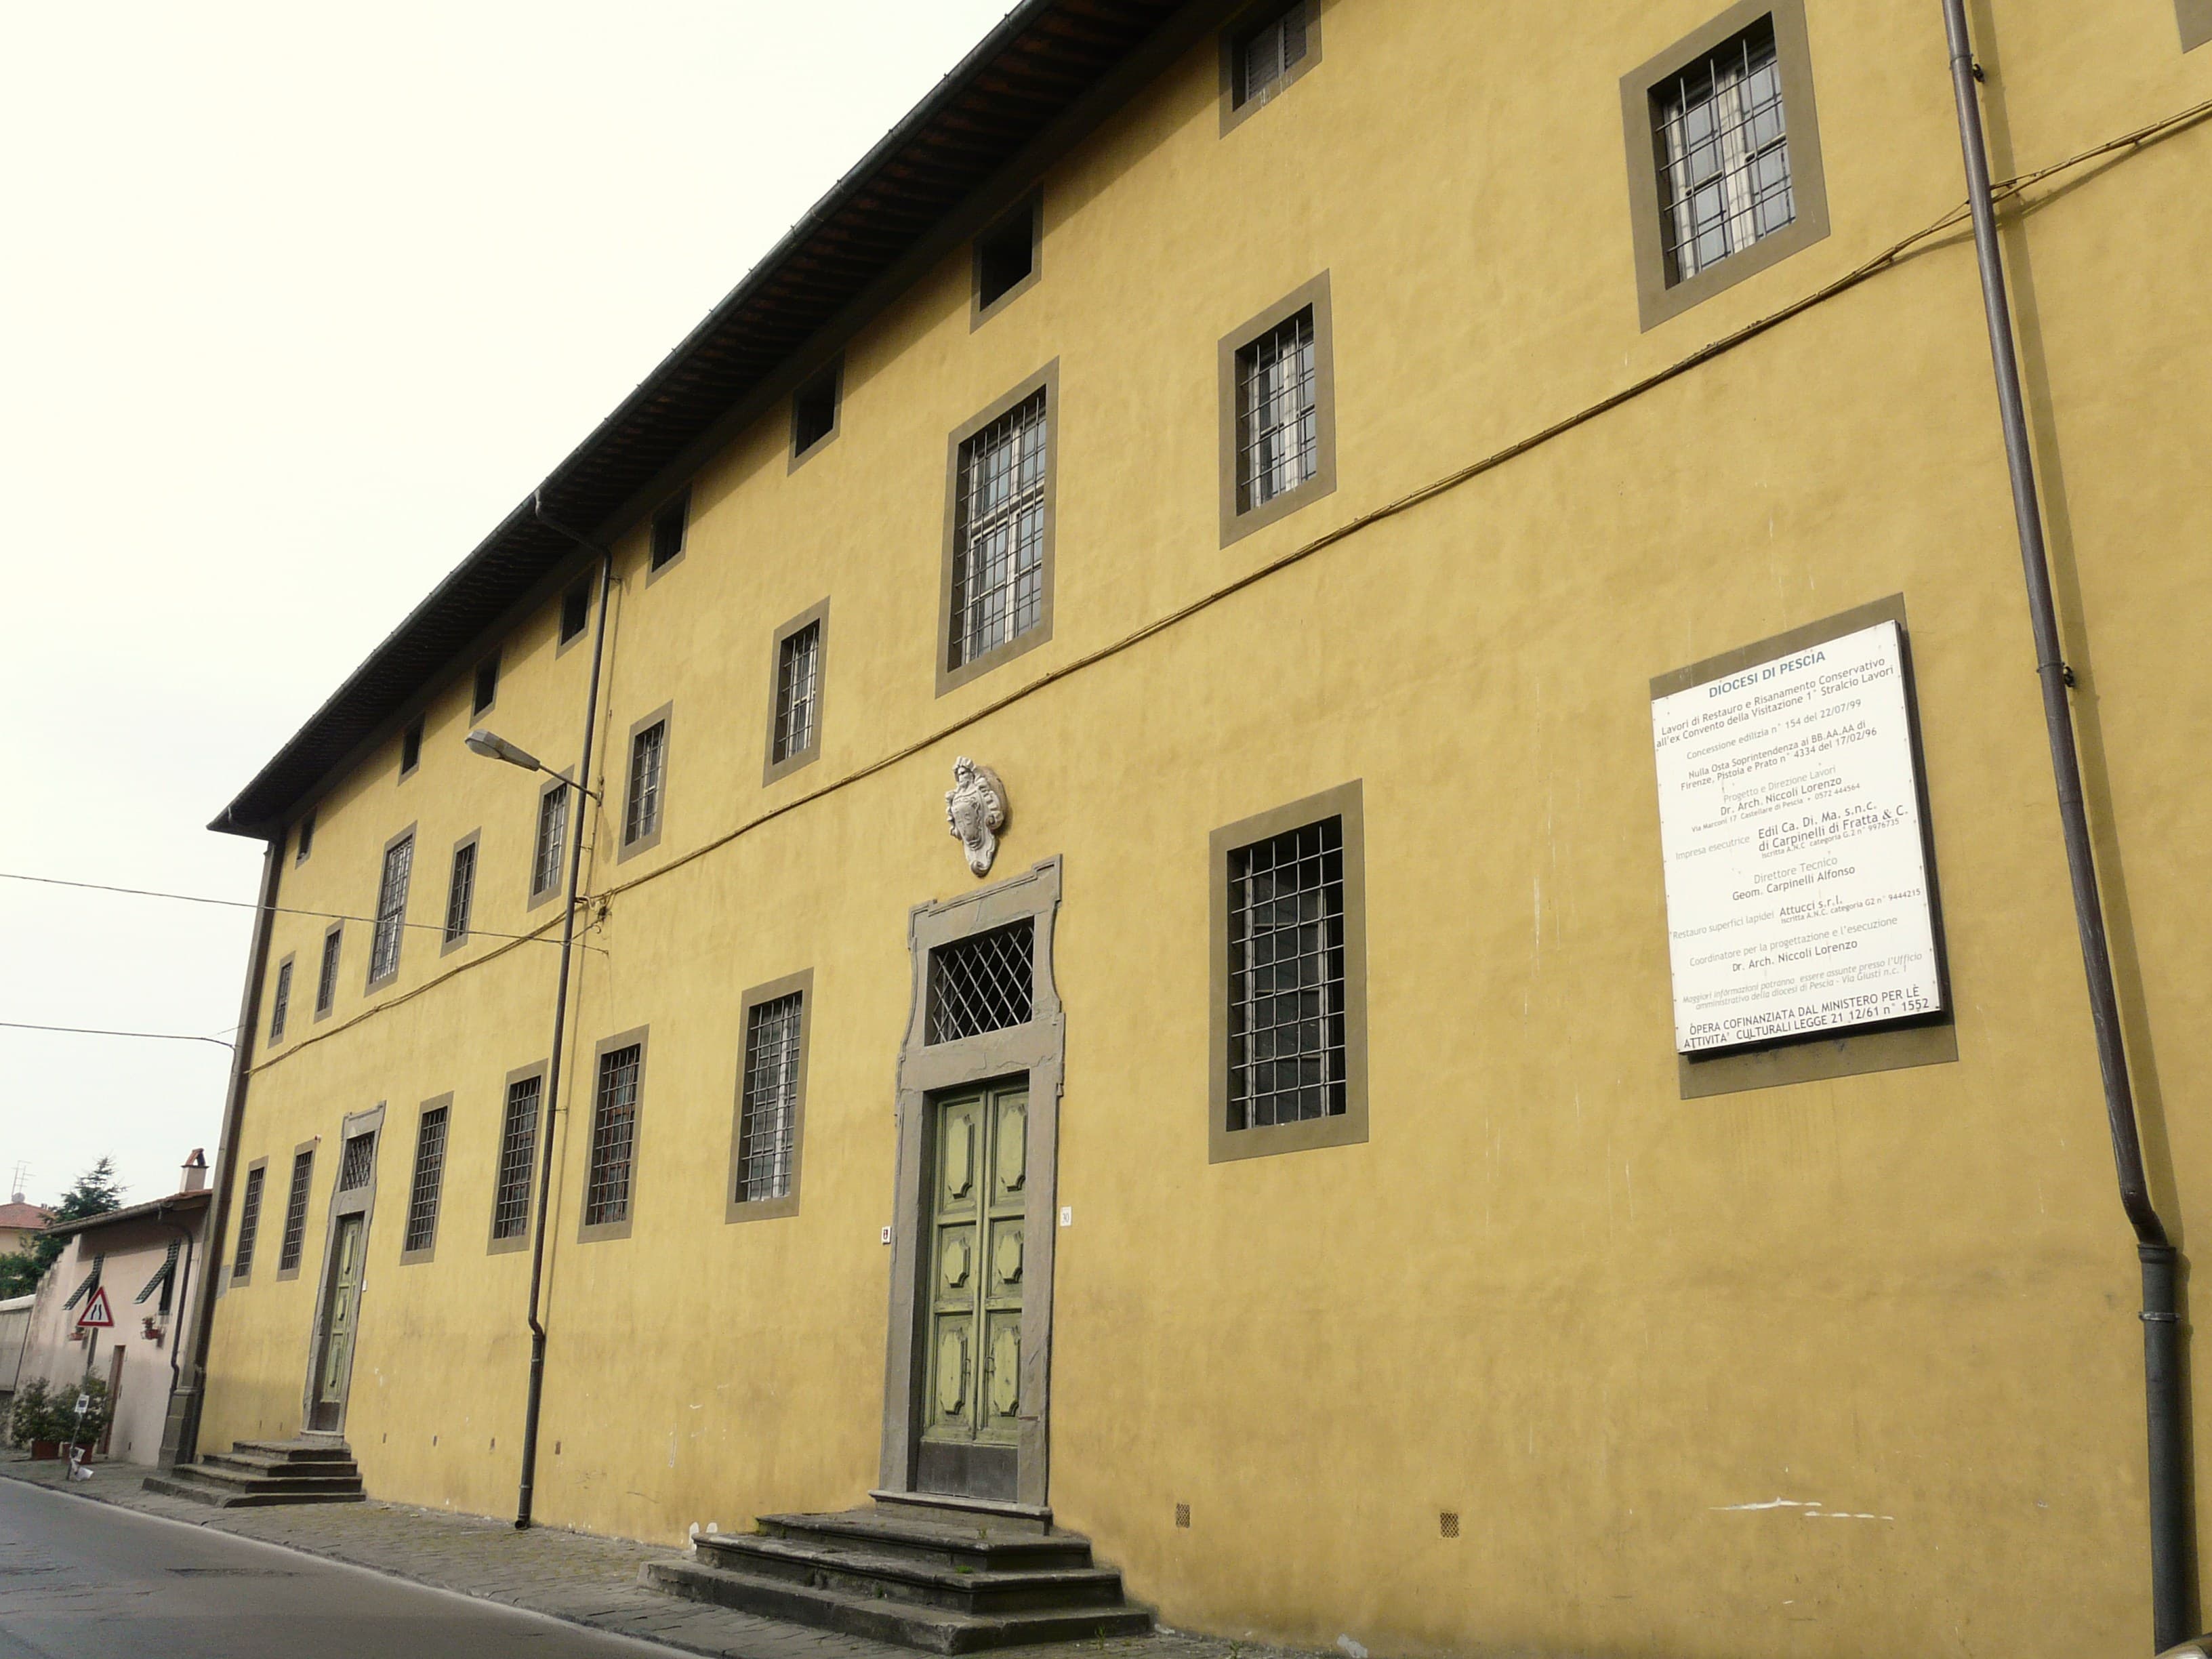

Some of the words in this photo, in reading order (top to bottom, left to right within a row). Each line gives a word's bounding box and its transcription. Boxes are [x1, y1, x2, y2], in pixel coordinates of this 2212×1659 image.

[1709, 673, 1758, 697] DIOCESI
[1763, 667, 1776, 680] DI
[1780, 651, 1825, 674] PESCIA
[1656, 735, 1680, 747] all'ex
[1683, 721, 1724, 739] Convento
[1728, 713, 1749, 725] della
[1752, 695, 1803, 717] Visitazione
[1822, 678, 1858, 695] Stralcio
[1862, 665, 1893, 683] Lavori
[1662, 720, 1689, 735] Lavori
[1692, 716, 1700, 726] di
[1702, 704, 1742, 722] Restauro
[1755, 680, 1816, 705] Risanamento
[1819, 659, 1885, 684] Conservativo
[1687, 740, 1736, 759] Concessione
[1739, 730, 1769, 743] edilizia
[1786, 718, 1801, 729] 154
[1804, 713, 1818, 723] del
[1821, 699, 1861, 718] 22/07/99
[1689, 768, 1709, 779] Nulla
[1712, 762, 1729, 772] Osta
[1732, 742, 1799, 766] Soprintendenza
[1801, 737, 1809, 746] ai
[1857, 720, 1865, 729] di
[1717, 767, 1744, 781] Pistoia
[1755, 758, 1777, 770] Prato
[1818, 741, 1832, 752] del
[1837, 728, 1877, 746] 17/02/96
[1721, 806, 1734, 815] Dr.
[1765, 787, 1798, 804] Niccoli
[1801, 777, 1842, 794] Lorenzo
[1724, 789, 1759, 802] Progetto
[1768, 774, 1807, 790] Direzione
[1810, 765, 1835, 779] Lavori
[1759, 825, 1778, 839] Edil
[1782, 822, 1799, 833] Ca.
[1803, 815, 1818, 827] Di.
[1822, 811, 1841, 823] Ma.
[1759, 840, 1769, 851] di
[1773, 824, 1825, 848] Carpinelli
[1829, 823, 1839, 834] di
[1843, 815, 1878, 830] Fratta
[1883, 809, 1891, 819] &
[1897, 805, 1908, 815] C.
[1676, 847, 1706, 860] Impresa
[1754, 867, 1797, 884] Direttore
[1800, 857, 1837, 872] Tecnico
[1767, 873, 1814, 893] Carpinelli
[1818, 866, 1855, 882] Alfonso
[1780, 901, 1815, 916] Attucci
[1673, 926, 1707, 939] Restauro
[1690, 949, 1740, 966] Coordinatore
[1744, 945, 1757, 956] per
[1760, 943, 1767, 951] la
[1769, 930, 1829, 951] progettazione
[1841, 917, 1898, 935] l'esecuzione
[1748, 957, 1774, 968] Arch.
[1778, 947, 1811, 963] Niccoli
[1816, 941, 1858, 956] Lorenzo
[1689, 1023, 1721, 1035] OPERA
[1723, 1009, 1795, 1029] COFINANZIATA
[1798, 1004, 1818, 1017] DAL
[1822, 994, 1878, 1012] MINISTERO
[1882, 990, 1902, 1002] PER
[1736, 1022, 1790, 1039] CULTURALI
[1795, 1015, 1828, 1030] LEGGE
[1831, 1013, 1843, 1023] 21
[1849, 1006, 1879, 1020] 12/61
[1902, 998, 1929, 1011] 1552
